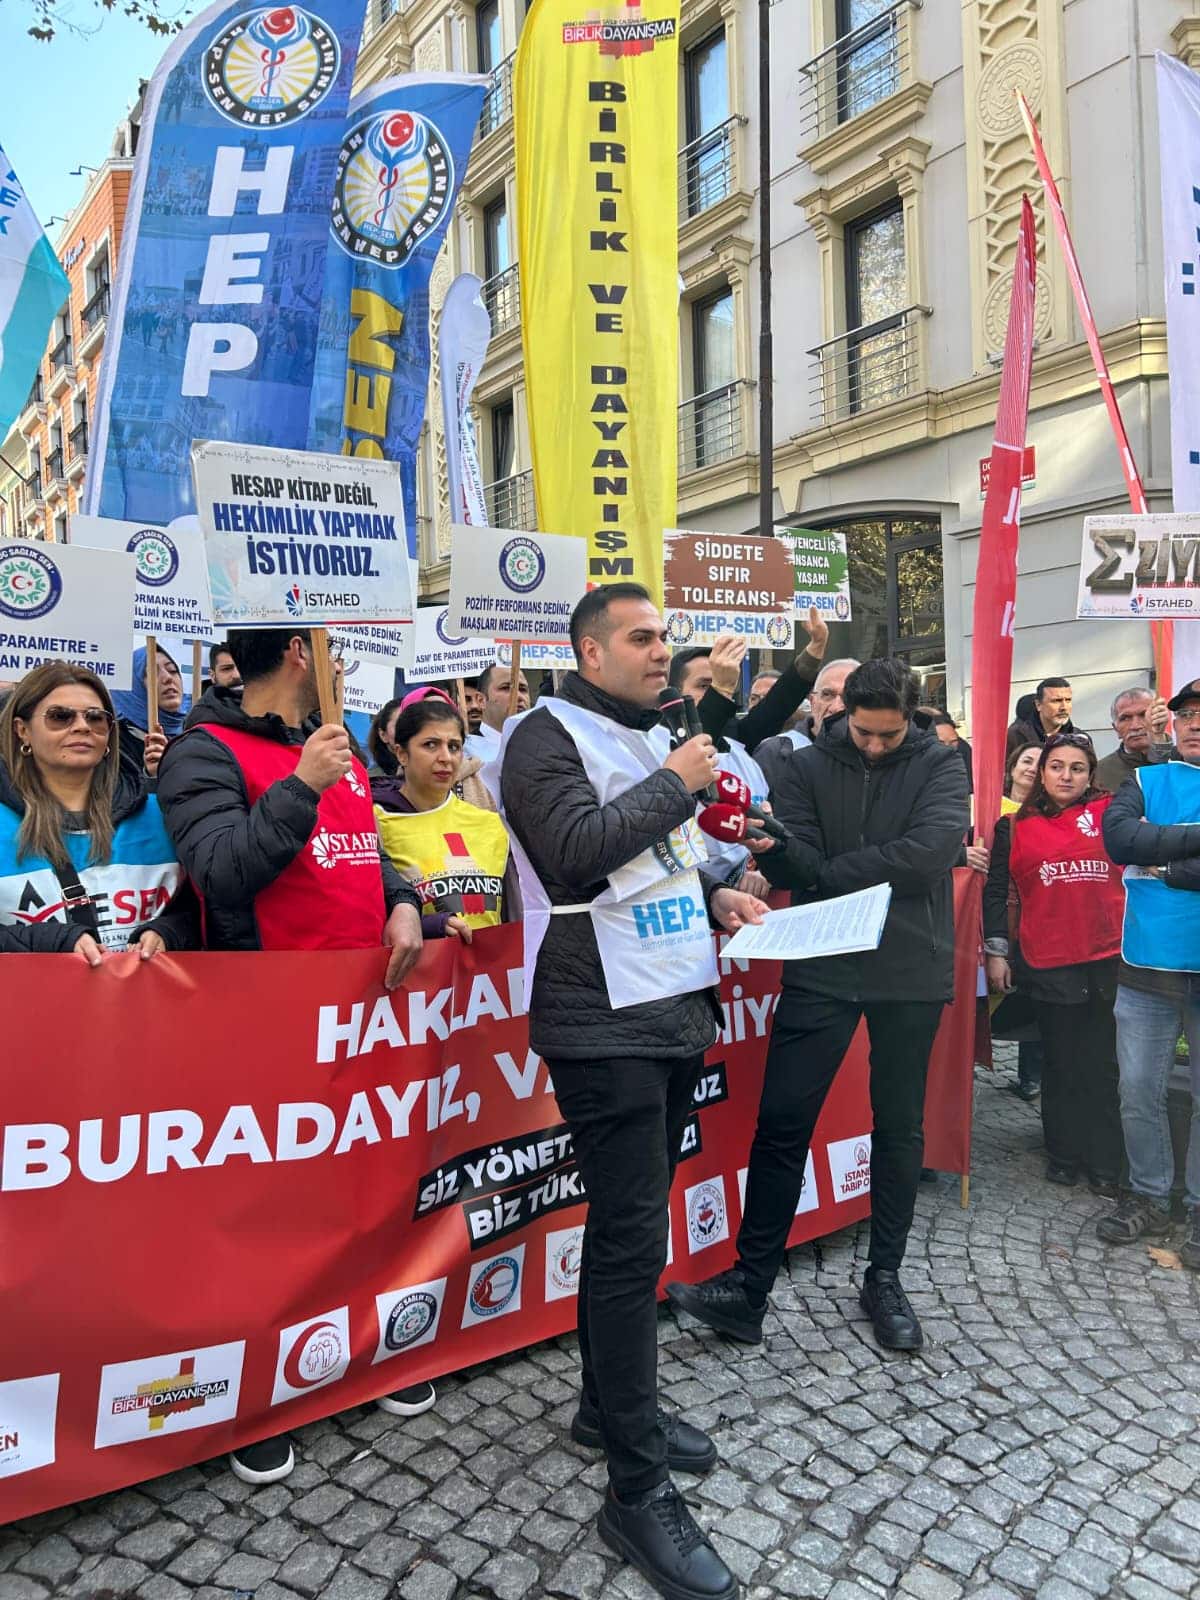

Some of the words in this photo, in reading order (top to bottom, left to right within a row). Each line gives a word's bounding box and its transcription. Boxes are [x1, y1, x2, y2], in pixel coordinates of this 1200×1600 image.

[242, 111, 287, 124] HEP
[588, 81, 628, 252] BİRLİK
[354, 238, 399, 263] HEP
[181, 145, 294, 397] HEP
[588, 283, 628, 333] VE
[590, 365, 634, 576] DAYANIŞM
[231, 473, 285, 498] HESAP
[287, 476, 331, 503] KİTAP
[334, 481, 378, 509] DEĞİL,
[213, 501, 318, 536] HEKİMLİK
[319, 510, 397, 541] YAPMAK
[247, 535, 380, 577] İSTİYORUZ.
[694, 538, 764, 561] ŞİDDETE
[794, 554, 829, 568] NSANCA
[708, 565, 750, 583] SIFIR
[797, 572, 828, 588] YAŞAM!
[178, 598, 198, 608] HYP
[304, 590, 360, 607] İSTAHED
[465, 595, 494, 610] POZİTİF
[495, 599, 541, 614] PERFORMANS
[682, 586, 776, 606] TOLERANS!
[795, 595, 834, 609] HEP-SEN
[1145, 597, 1193, 608] İSTAHED
[133, 618, 162, 631] BİZİM
[460, 616, 497, 633] MAAŞLARI
[498, 617, 533, 632] NEGATİFE
[694, 615, 765, 634] HEP-SEN
[0, 633, 86, 654] PARAMETRE
[353, 639, 399, 657] ÇEVİRDİNİZ!
[521, 645, 577, 659] HEP-SE
[433, 652, 443, 661] DE
[448, 661, 479, 672] YETİŞSİN
[1, 1064, 481, 1192] BURADAYIZ,
[417, 1168, 460, 1212] SİZ
[464, 1133, 575, 1189] YÖNET
[693, 1073, 722, 1102] UZ
[469, 1195, 522, 1240] BİZ
[527, 1171, 586, 1213] TÜK
[680, 1123, 697, 1153] Z!
